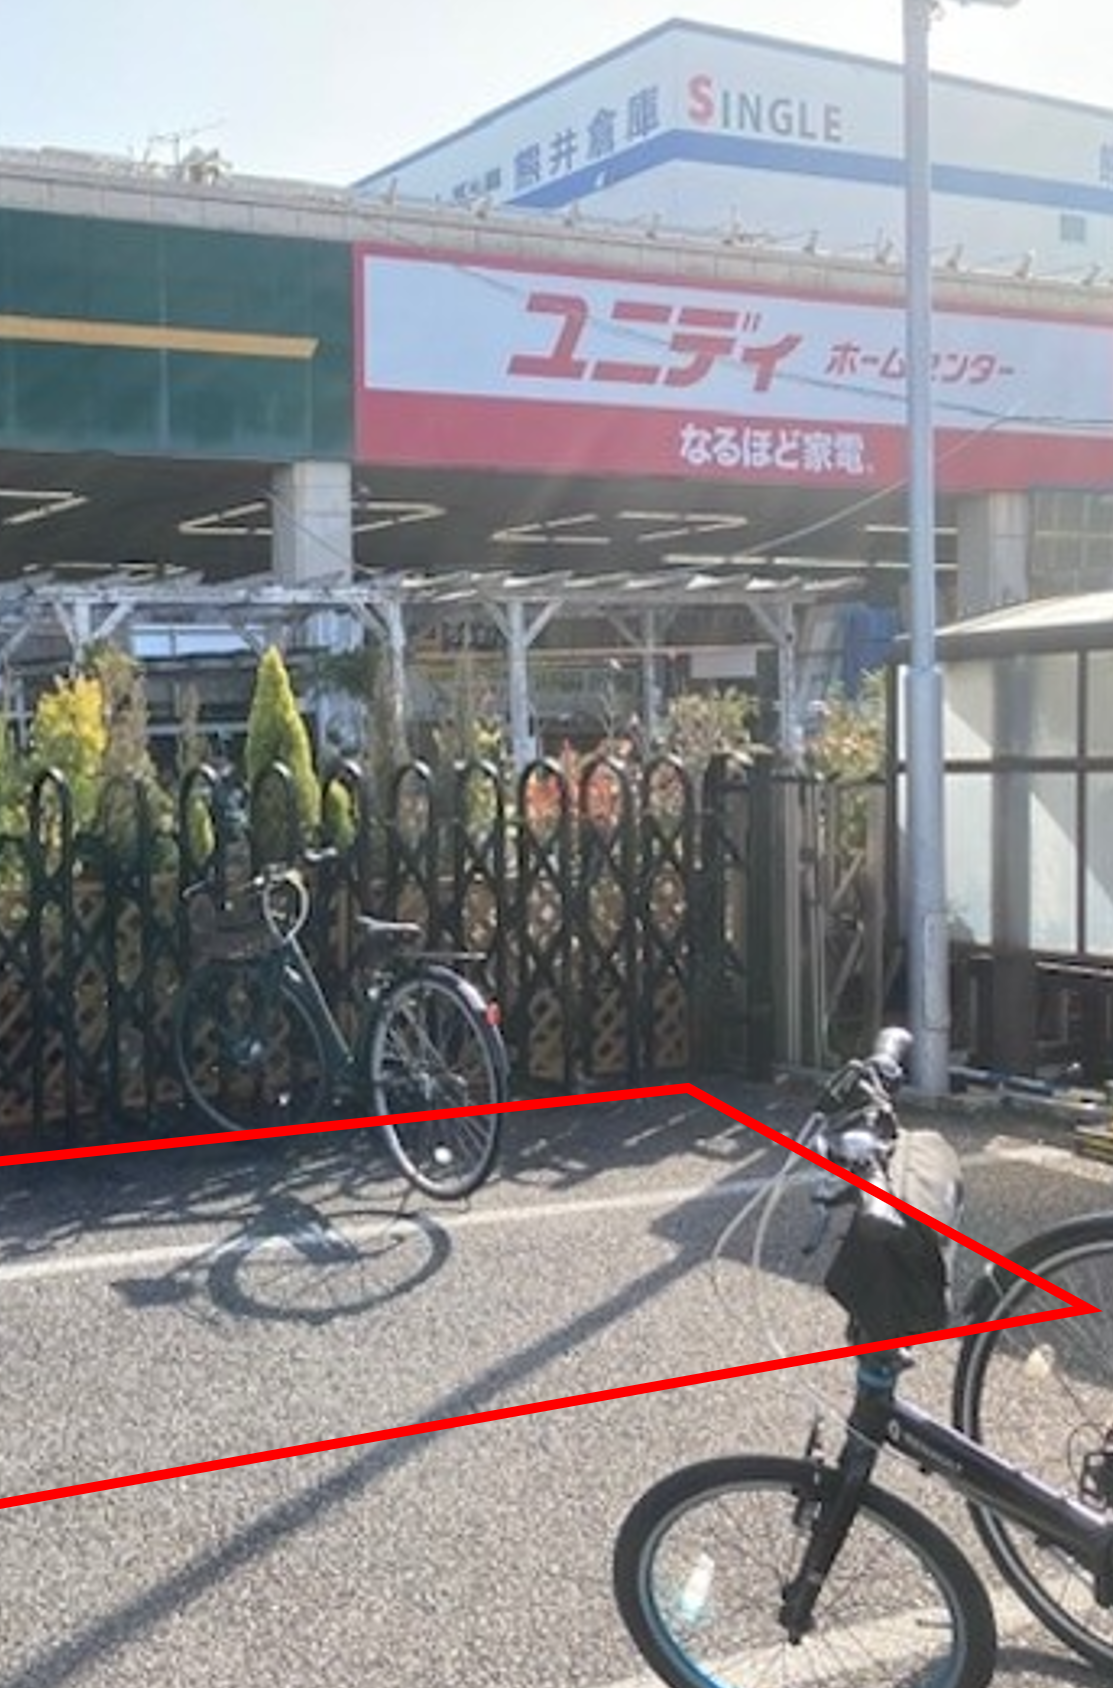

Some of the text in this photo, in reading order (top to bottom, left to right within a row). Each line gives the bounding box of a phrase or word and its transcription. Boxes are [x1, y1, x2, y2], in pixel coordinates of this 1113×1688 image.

[687, 75, 843, 143] SINGLE
[507, 292, 803, 392] ユニディ
[680, 424, 864, 474] なるほど家電
